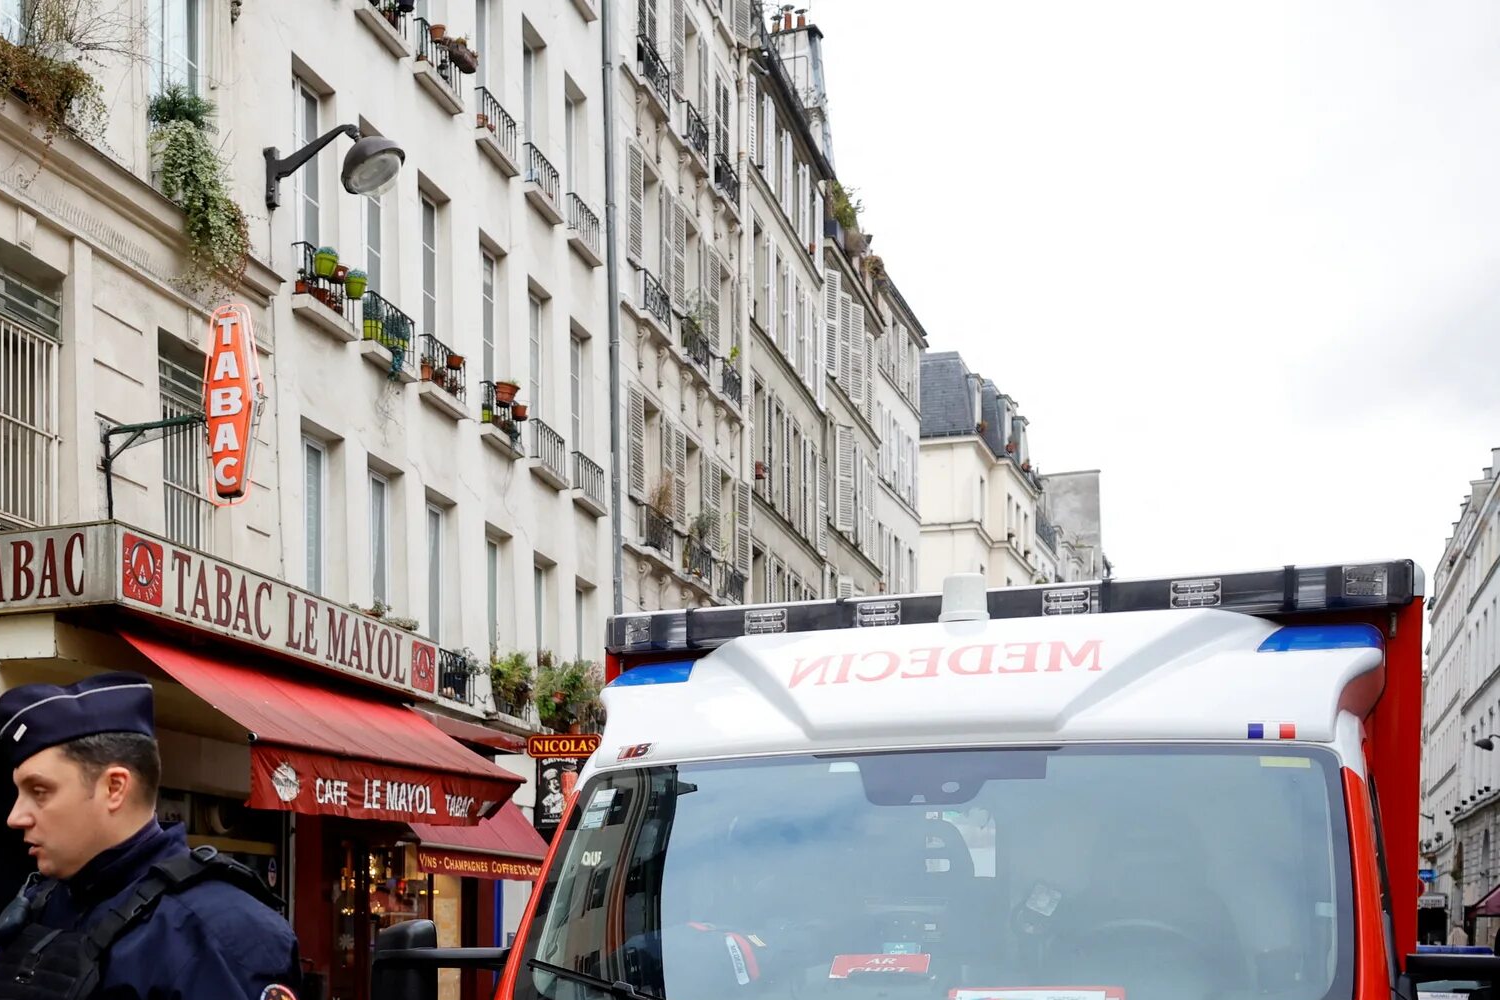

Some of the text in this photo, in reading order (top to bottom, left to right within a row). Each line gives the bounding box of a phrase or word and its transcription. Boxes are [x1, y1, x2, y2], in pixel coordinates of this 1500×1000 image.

[210, 317, 243, 487] TABAC
[171, 549, 273, 642] TABAC
[285, 591, 319, 656] LE
[325, 606, 407, 685] MAYOL
[532, 739, 597, 753] NICOLAS
[315, 777, 349, 807] CAFE
[363, 777, 381, 810] LE
[385, 780, 437, 815] MAYOL
[445, 793, 475, 818] TABAC
[419, 853, 438, 868] VINS
[443, 856, 489, 873] CHAMPAGNES
[491, 861, 527, 877] COFFRETS
